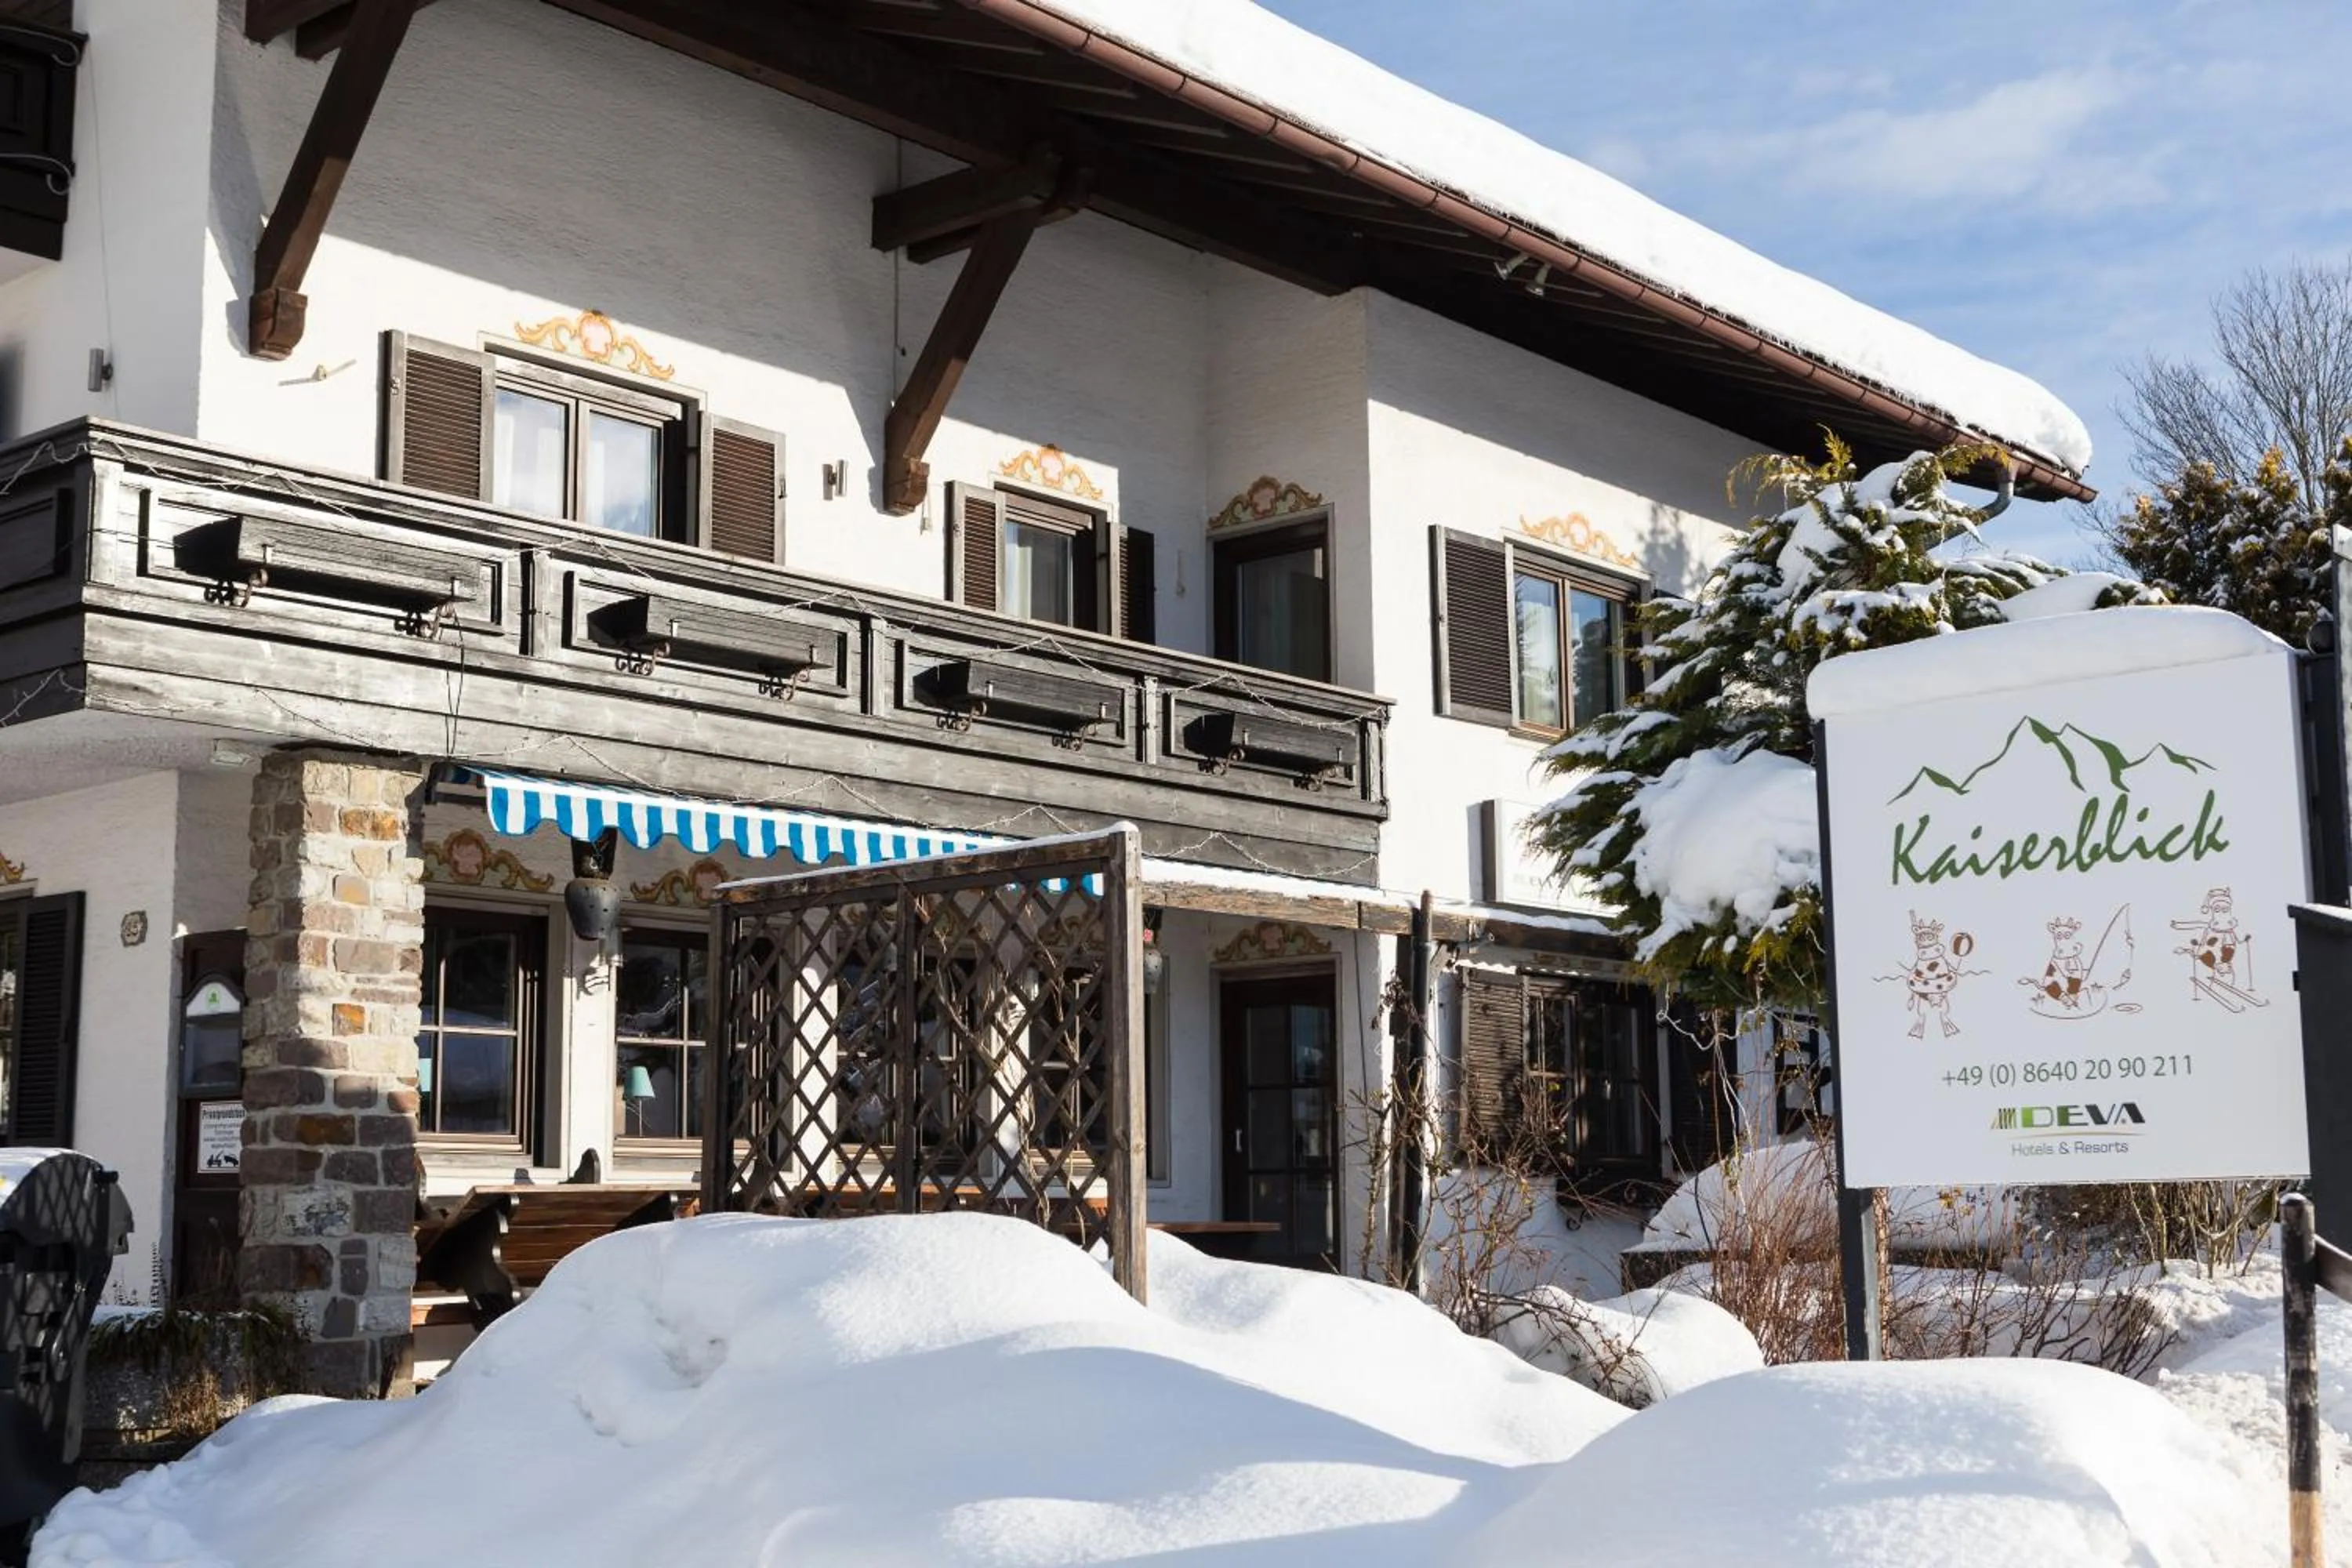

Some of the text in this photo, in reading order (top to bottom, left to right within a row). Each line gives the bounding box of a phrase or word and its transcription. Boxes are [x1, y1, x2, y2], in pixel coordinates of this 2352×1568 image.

[1892, 789, 2230, 885] Kaiserblick
[1942, 1054, 2192, 1087] +49 (0) 8640 20 90 211
[2020, 1102, 2146, 1129] DEVA
[2011, 1141, 2129, 1156] Hotels & Resorts
